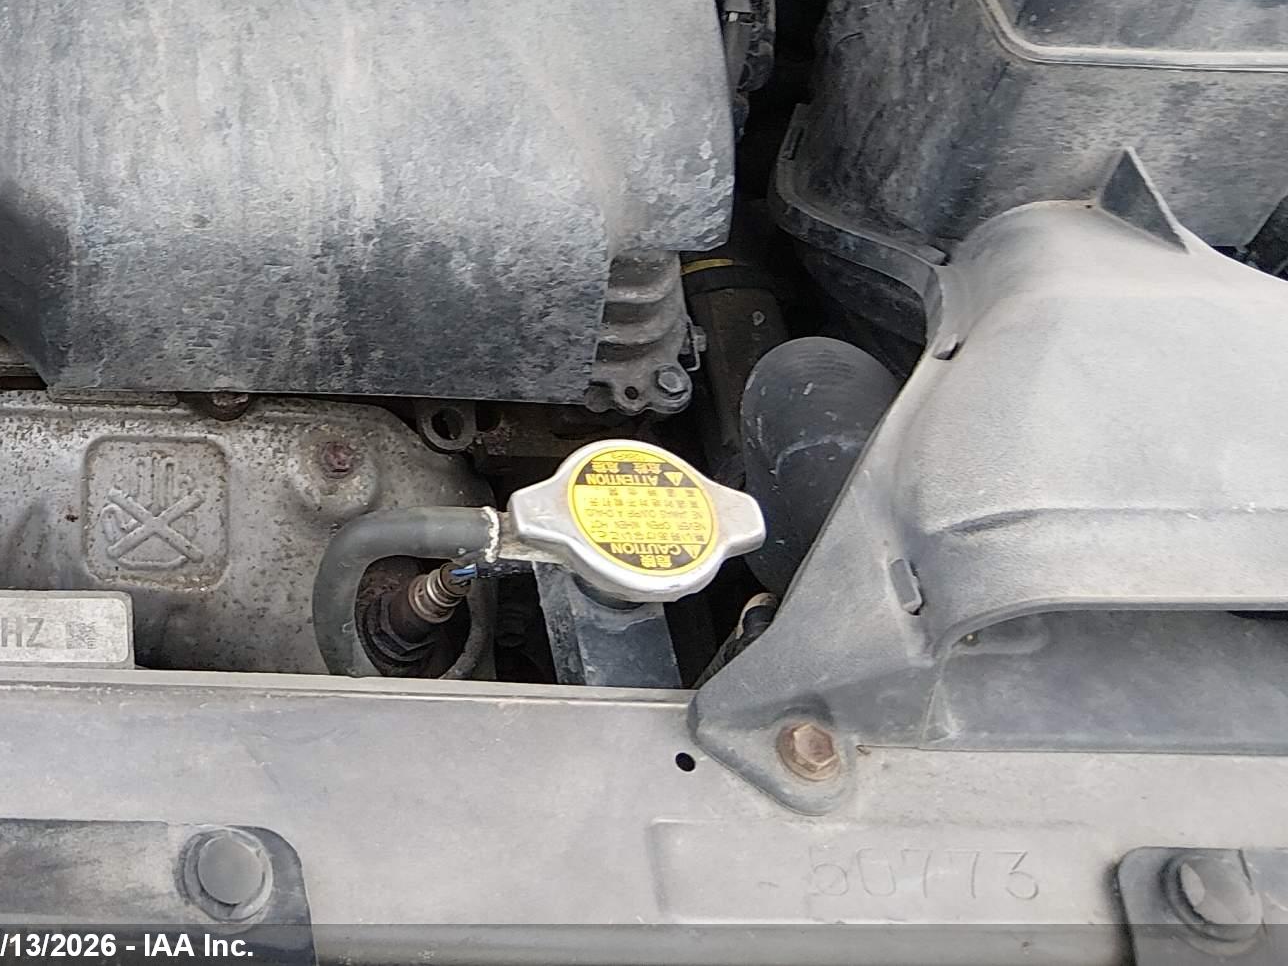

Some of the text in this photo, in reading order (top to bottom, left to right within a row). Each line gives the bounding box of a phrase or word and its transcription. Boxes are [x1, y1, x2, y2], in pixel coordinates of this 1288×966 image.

[585, 474, 658, 486] ATTENTION
[611, 543, 681, 554] CAUTION
[0, 617, 48, 648] HZ
